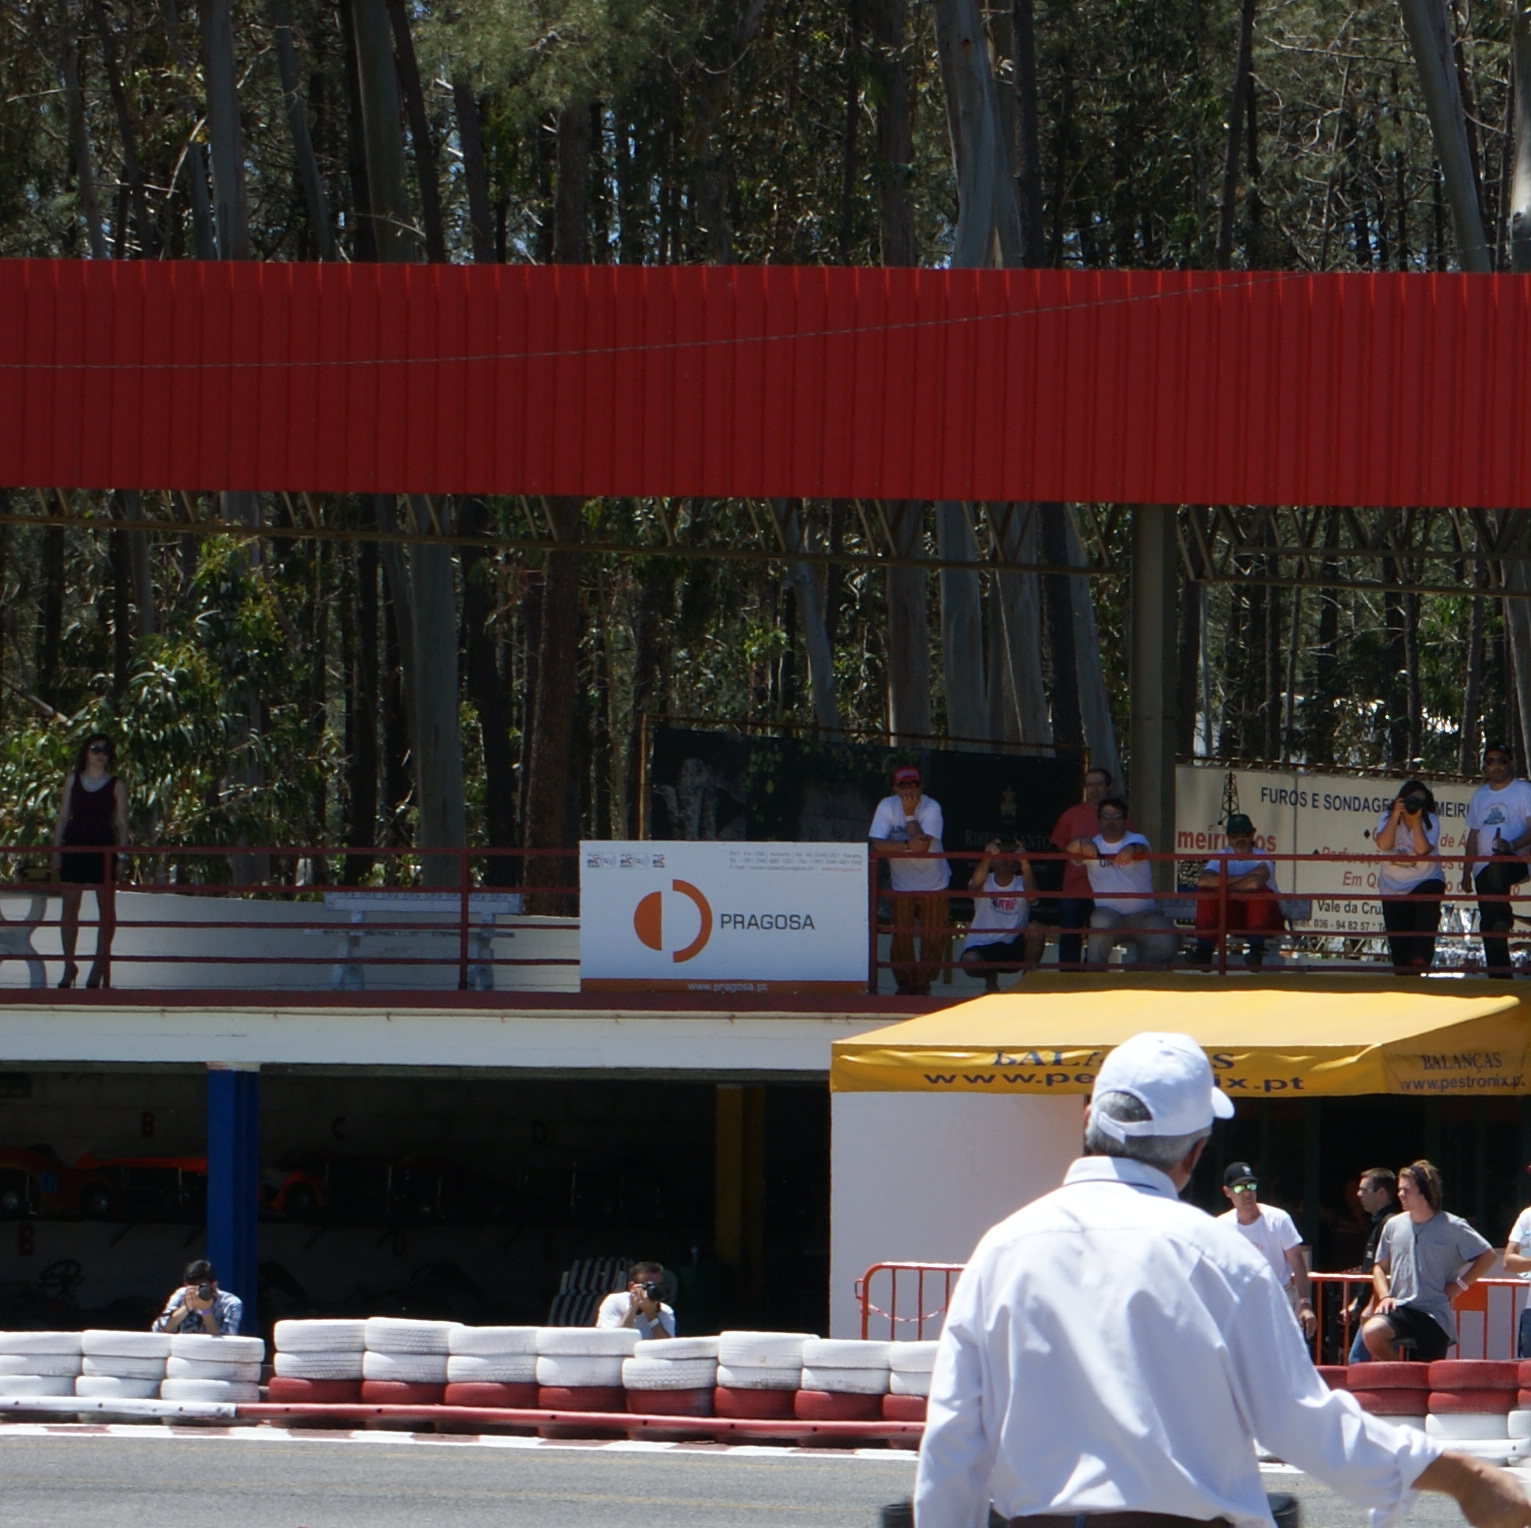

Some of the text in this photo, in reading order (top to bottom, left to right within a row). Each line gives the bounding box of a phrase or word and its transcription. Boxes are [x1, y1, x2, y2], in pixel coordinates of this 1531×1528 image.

[1261, 787, 1308, 808] FUROS
[1312, 793, 1320, 809] E
[1323, 794, 1393, 814] SONDAGE
[1343, 871, 1362, 887] Em
[1317, 899, 1383, 915] Vale da Cru
[720, 913, 816, 931] PRAGOSA
[687, 982, 768, 993] www.pragosa.pt
[1422, 1052, 1502, 1073] BALANÇAS
[923, 1073, 1305, 1092] www.peix.pt
[141, 1111, 155, 1138] B
